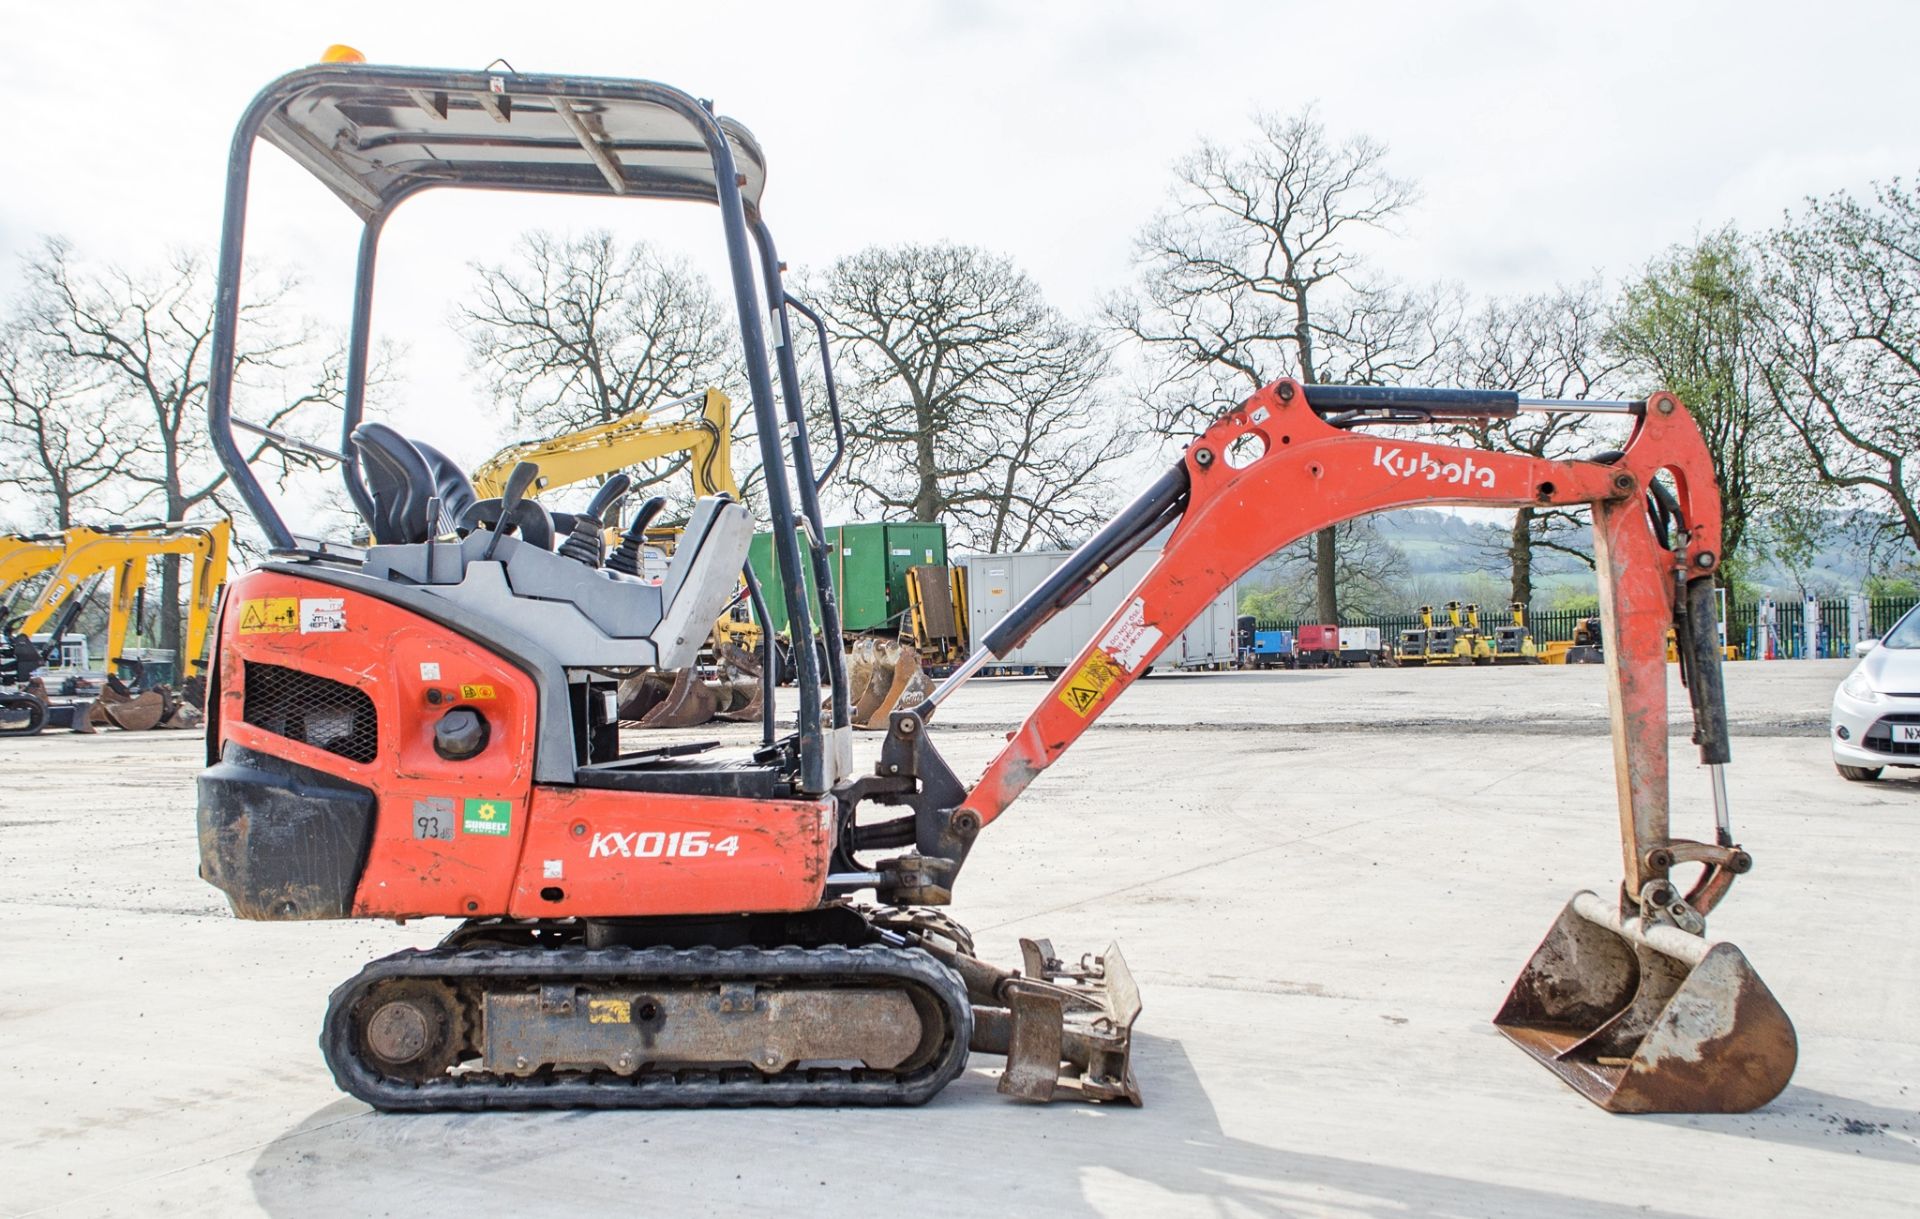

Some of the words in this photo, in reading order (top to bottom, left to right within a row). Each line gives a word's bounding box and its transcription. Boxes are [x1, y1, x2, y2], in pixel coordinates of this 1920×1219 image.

[1373, 446, 1496, 488] Kubota
[1110, 634, 1119, 645] DO
[1118, 621, 1129, 634] NOT
[417, 816, 438, 838] 93
[464, 820, 507, 832] SUNBELT
[588, 831, 740, 858] KX016-4
